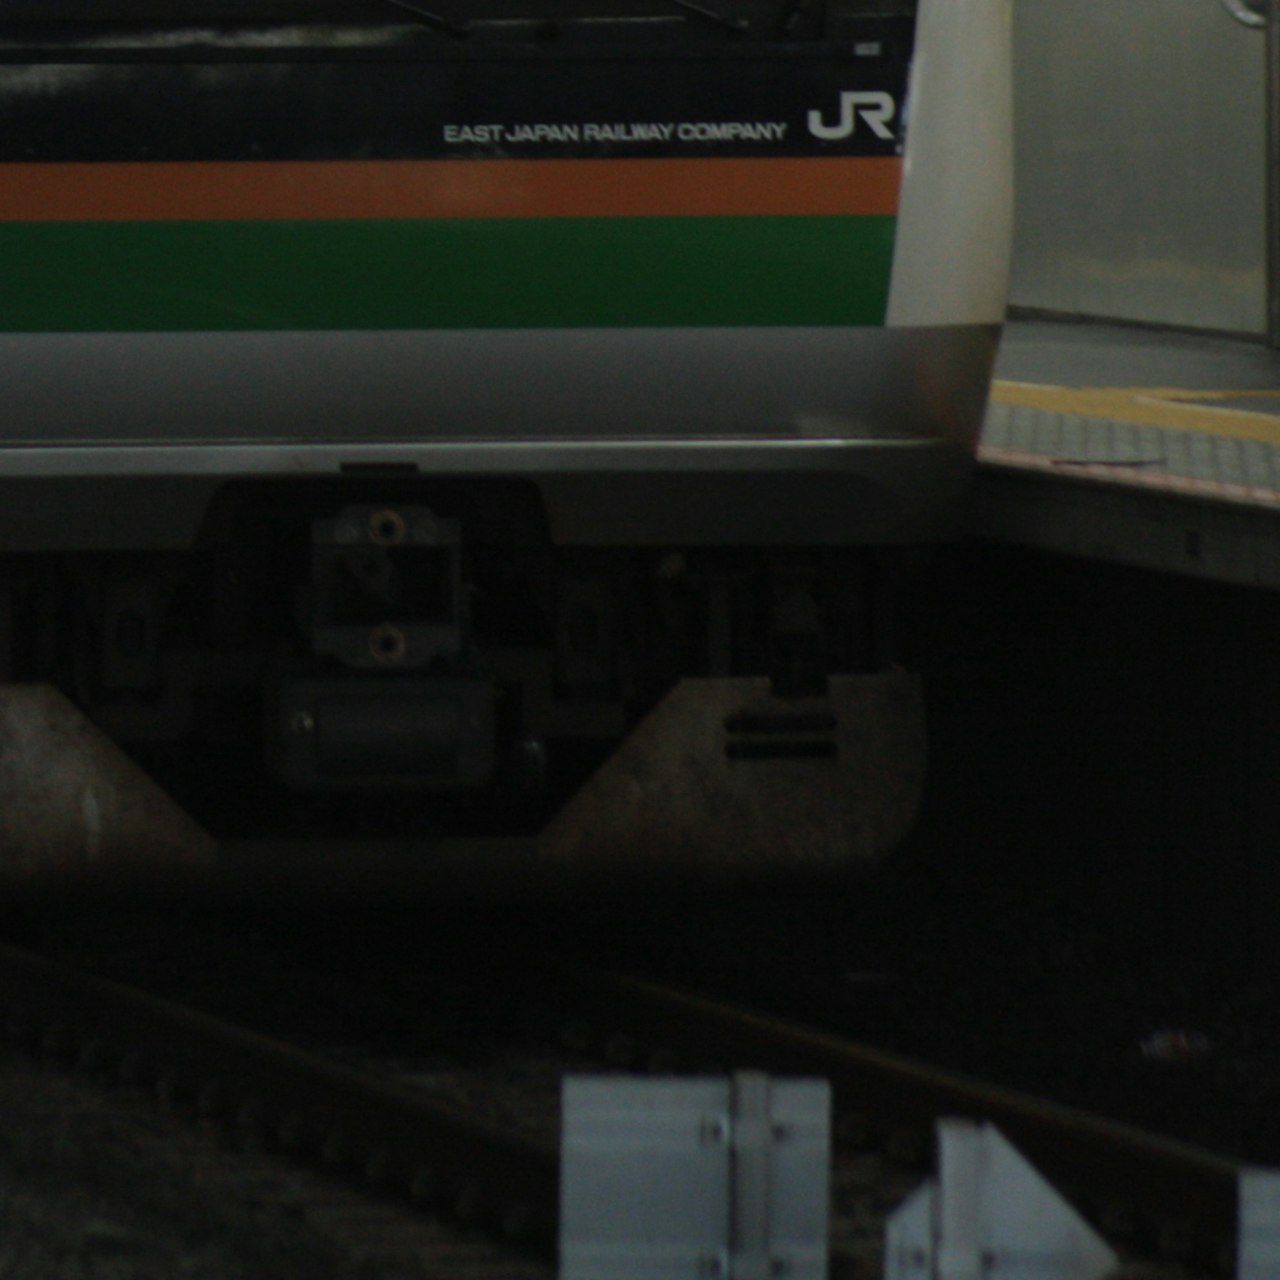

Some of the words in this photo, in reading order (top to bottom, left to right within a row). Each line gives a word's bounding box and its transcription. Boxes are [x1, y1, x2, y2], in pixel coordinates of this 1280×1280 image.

[443, 124, 504, 143] EAST
[504, 122, 581, 143] JAPAN
[583, 122, 673, 142] RAILWAY
[676, 121, 787, 141] COMPANY
[807, 90, 896, 140] JR
